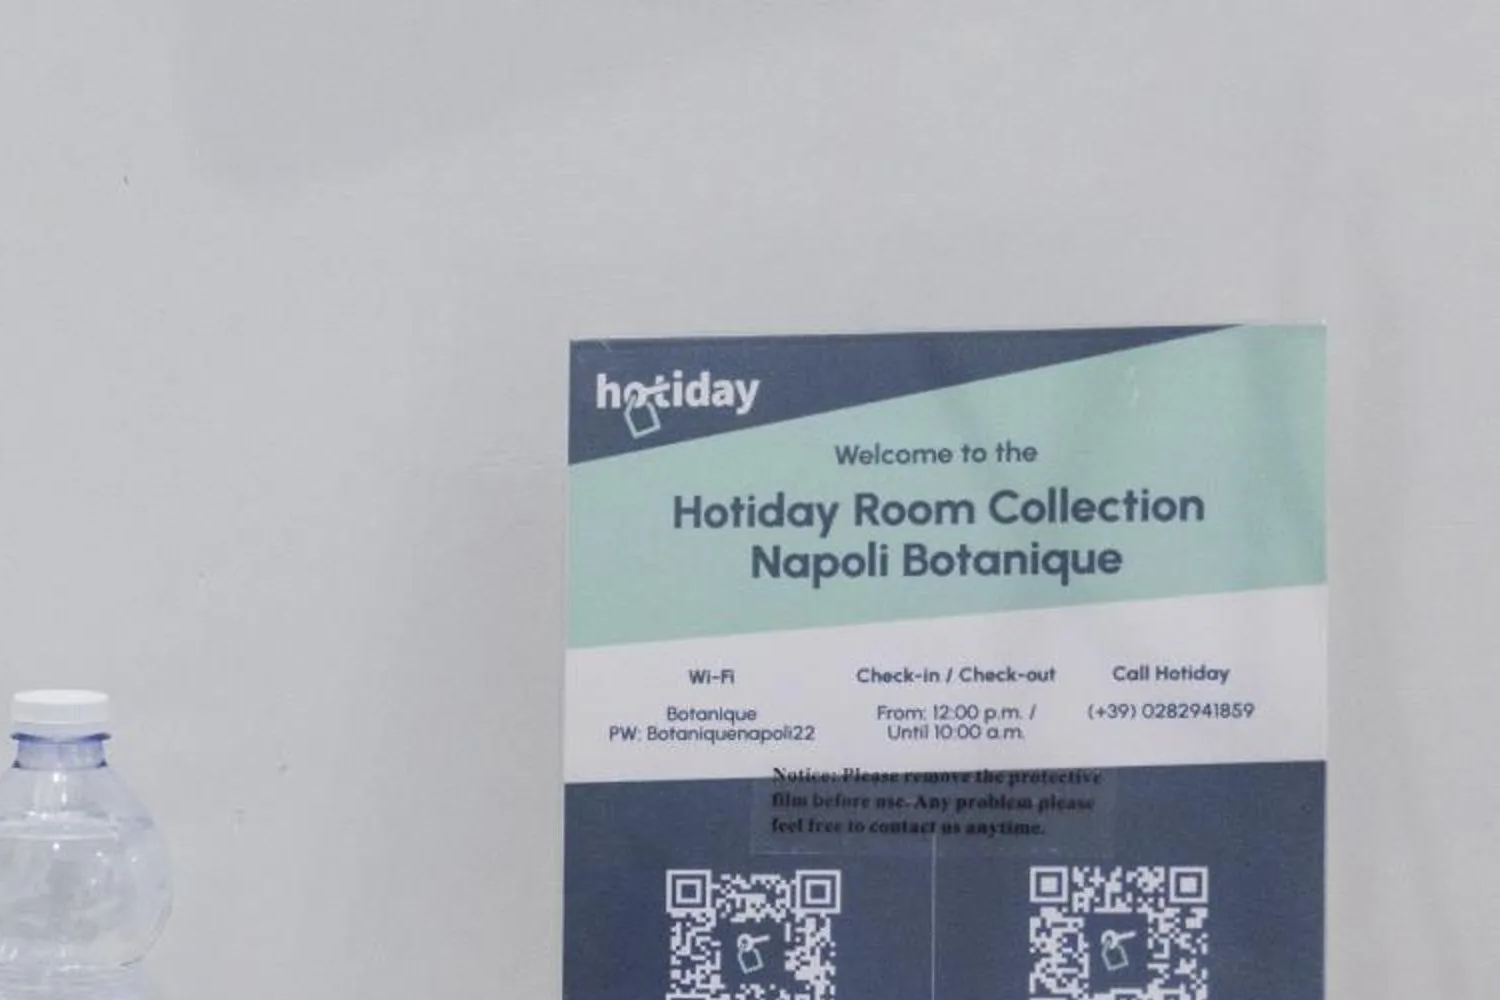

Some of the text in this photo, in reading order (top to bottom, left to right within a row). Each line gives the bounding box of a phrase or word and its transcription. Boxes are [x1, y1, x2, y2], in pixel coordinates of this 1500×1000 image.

[596, 370, 761, 415] hotiday
[834, 440, 1038, 466] Welcome to the
[673, 486, 1205, 538] Hotiday Room Collection
[751, 541, 1124, 589] Napoli Botanique
[688, 669, 736, 685] Wi-Fi
[856, 666, 941, 684] Check-in
[958, 666, 1056, 684] Check-out
[1112, 664, 1231, 686] Call Hotiday
[666, 706, 758, 726] Botanique
[876, 705, 927, 722] From:
[932, 704, 979, 722] 12:00
[983, 707, 1024, 725] p.m.
[1087, 702, 1256, 722] (+39) 0282941859
[608, 725, 817, 745] PW: Botaniquenapoli22
[887, 723, 929, 741] Until
[933, 724, 982, 741] 10:00
[773, 768, 1102, 787] Notice: Please remove the protective
[772, 793, 808, 808] film
[812, 794, 871, 810] before
[914, 795, 950, 813] Any
[955, 795, 1033, 814] problem
[1037, 796, 1095, 812] please
[771, 818, 804, 834] feel
[807, 818, 844, 834] free
[849, 819, 866, 834] to
[869, 819, 937, 834] contact
[941, 823, 961, 836] us
